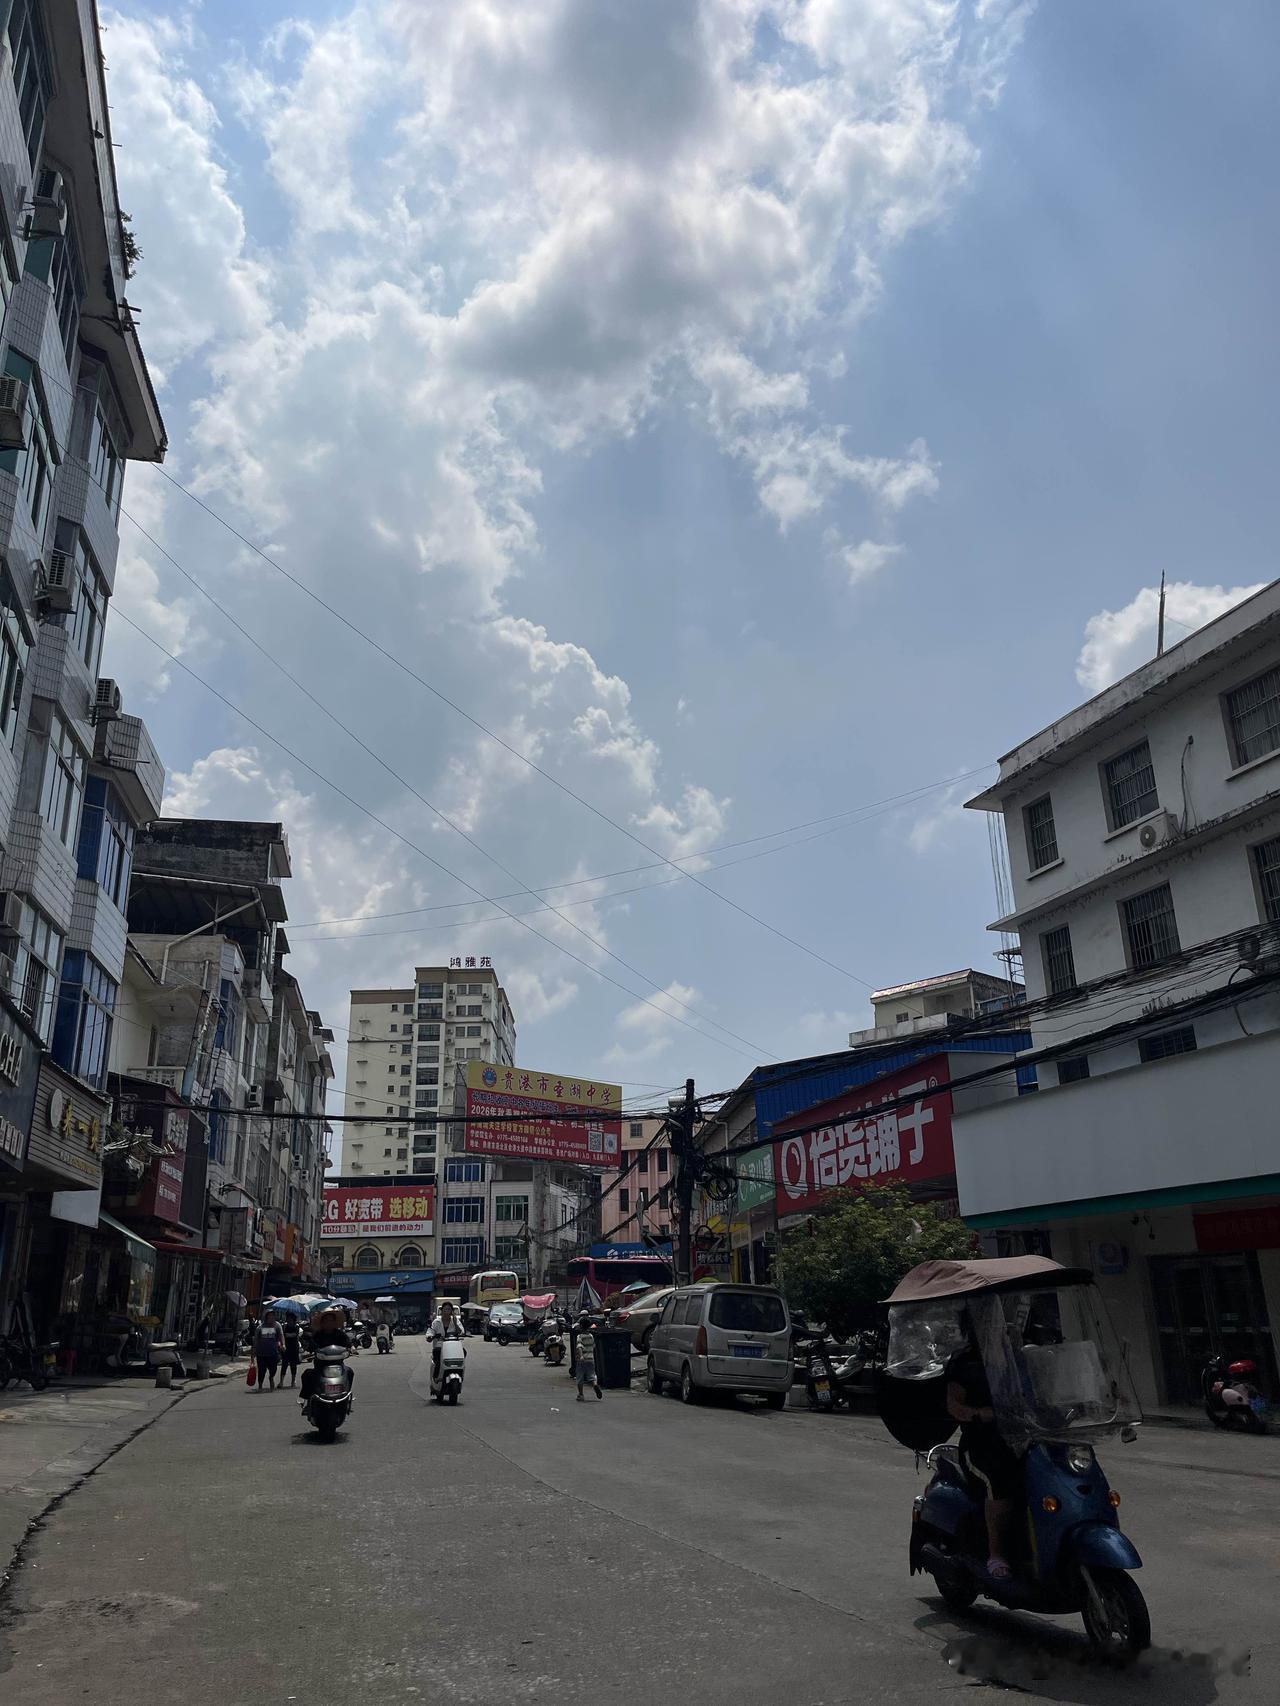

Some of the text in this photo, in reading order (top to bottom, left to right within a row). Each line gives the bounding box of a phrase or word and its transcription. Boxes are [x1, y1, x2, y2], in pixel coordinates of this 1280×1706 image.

[450, 956, 492, 968] 鸿雅苑
[501, 1070, 611, 1104] 贵港市圣湖中学
[345, 1197, 384, 1220] 好宽带
[389, 1196, 428, 1219] 选移动
